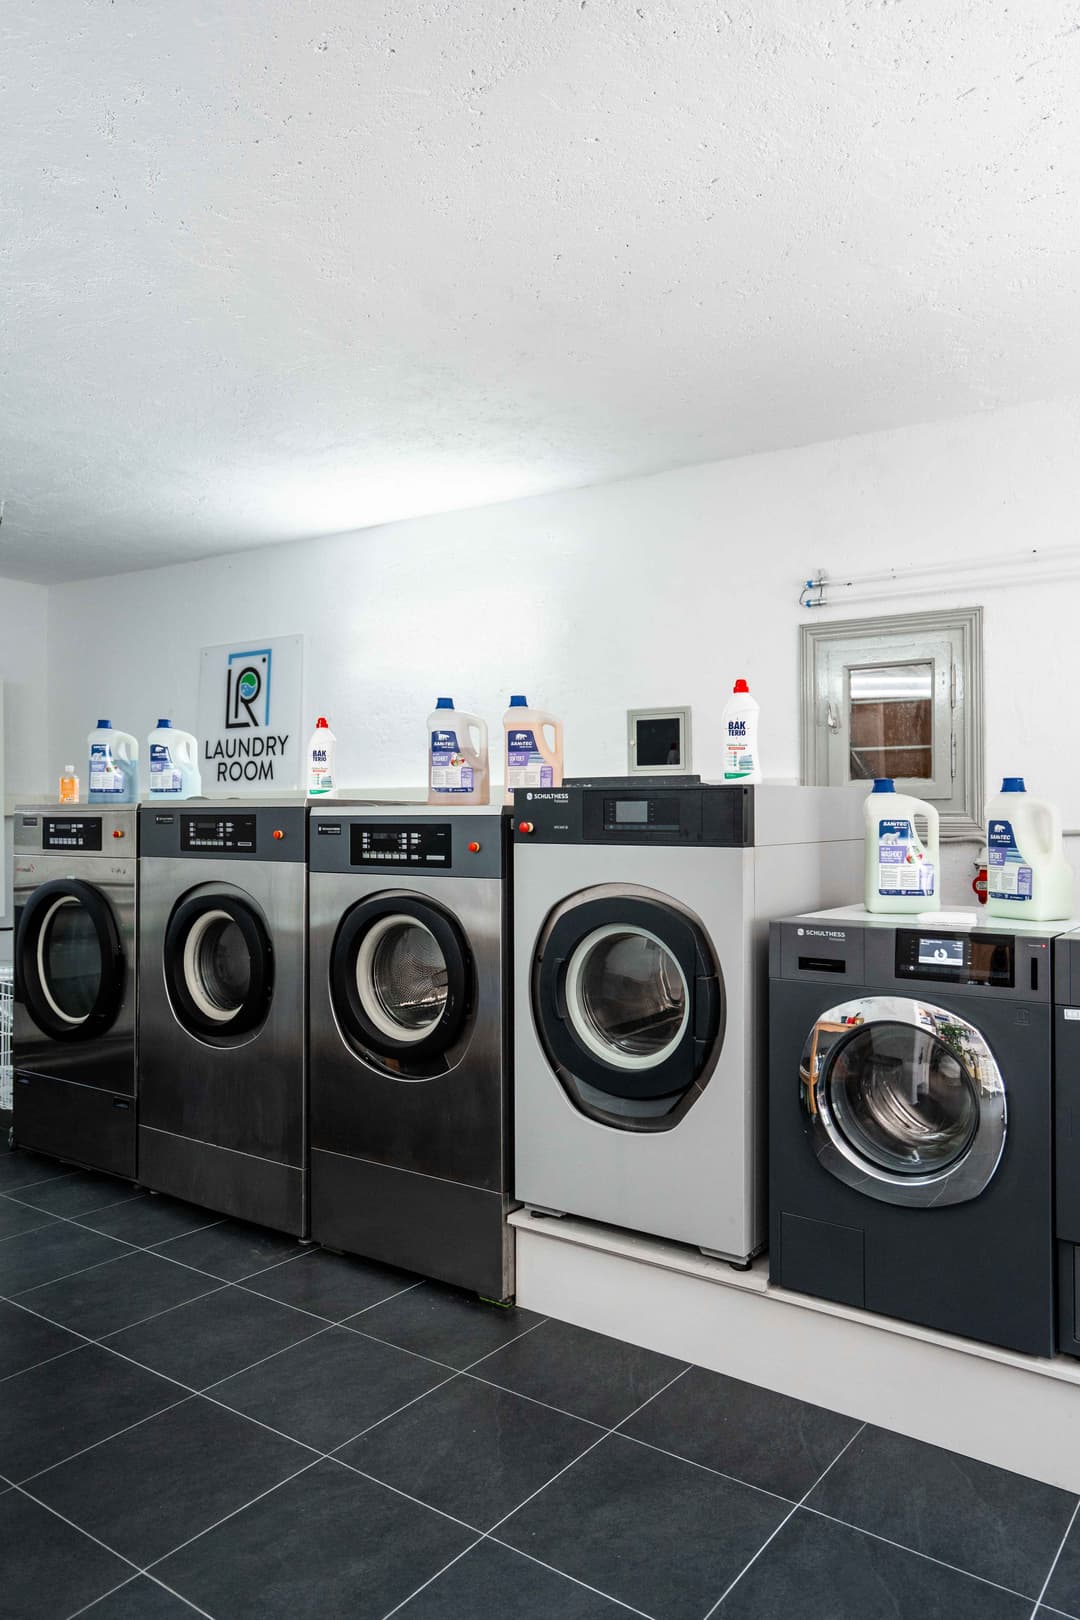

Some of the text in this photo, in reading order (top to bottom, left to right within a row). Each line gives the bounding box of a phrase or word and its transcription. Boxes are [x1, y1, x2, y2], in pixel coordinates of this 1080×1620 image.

[728, 721, 746, 730] BAK
[205, 735, 289, 760] LAUNDRY
[217, 760, 274, 782] ROOM
[805, 929, 846, 938] SCHULTHESS
